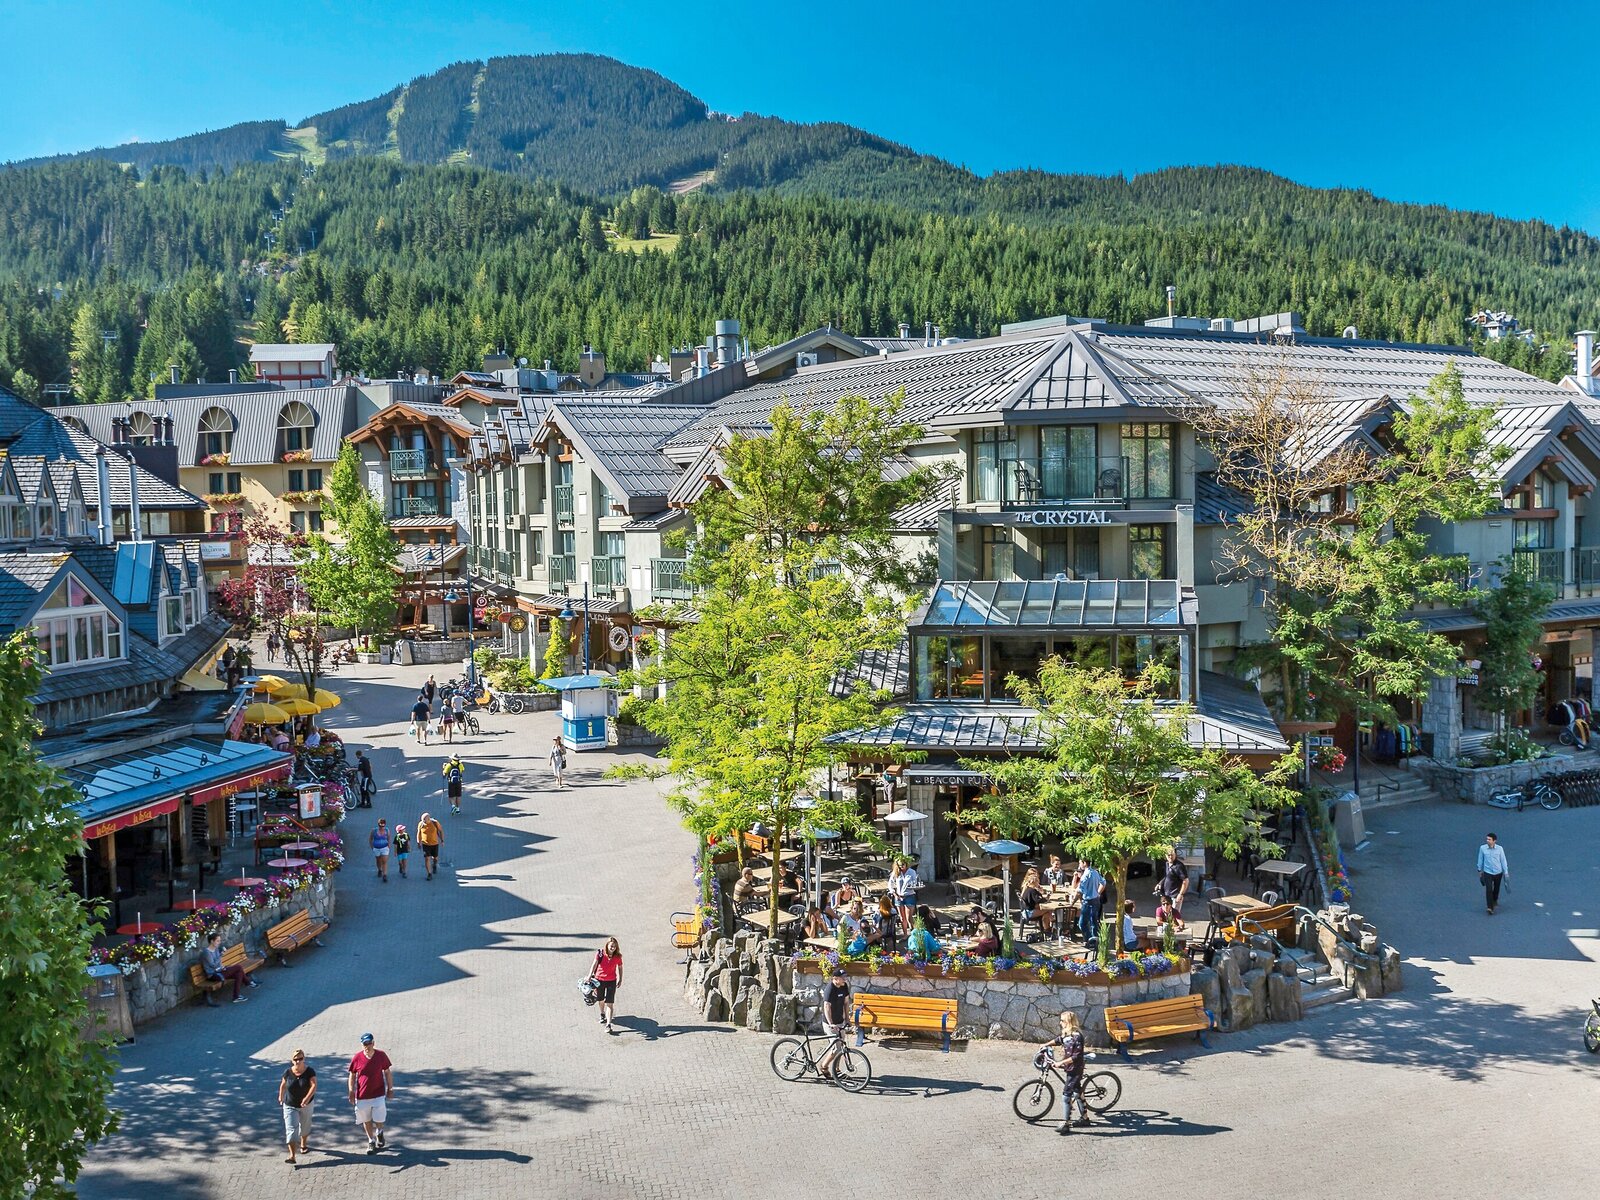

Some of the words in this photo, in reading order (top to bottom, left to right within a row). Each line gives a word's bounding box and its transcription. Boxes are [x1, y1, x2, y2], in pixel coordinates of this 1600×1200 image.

[1015, 511, 1031, 522] The
[1032, 510, 1111, 525] CRYSTAL
[923, 776, 965, 785] BEACON
[967, 776, 988, 785] PUB
